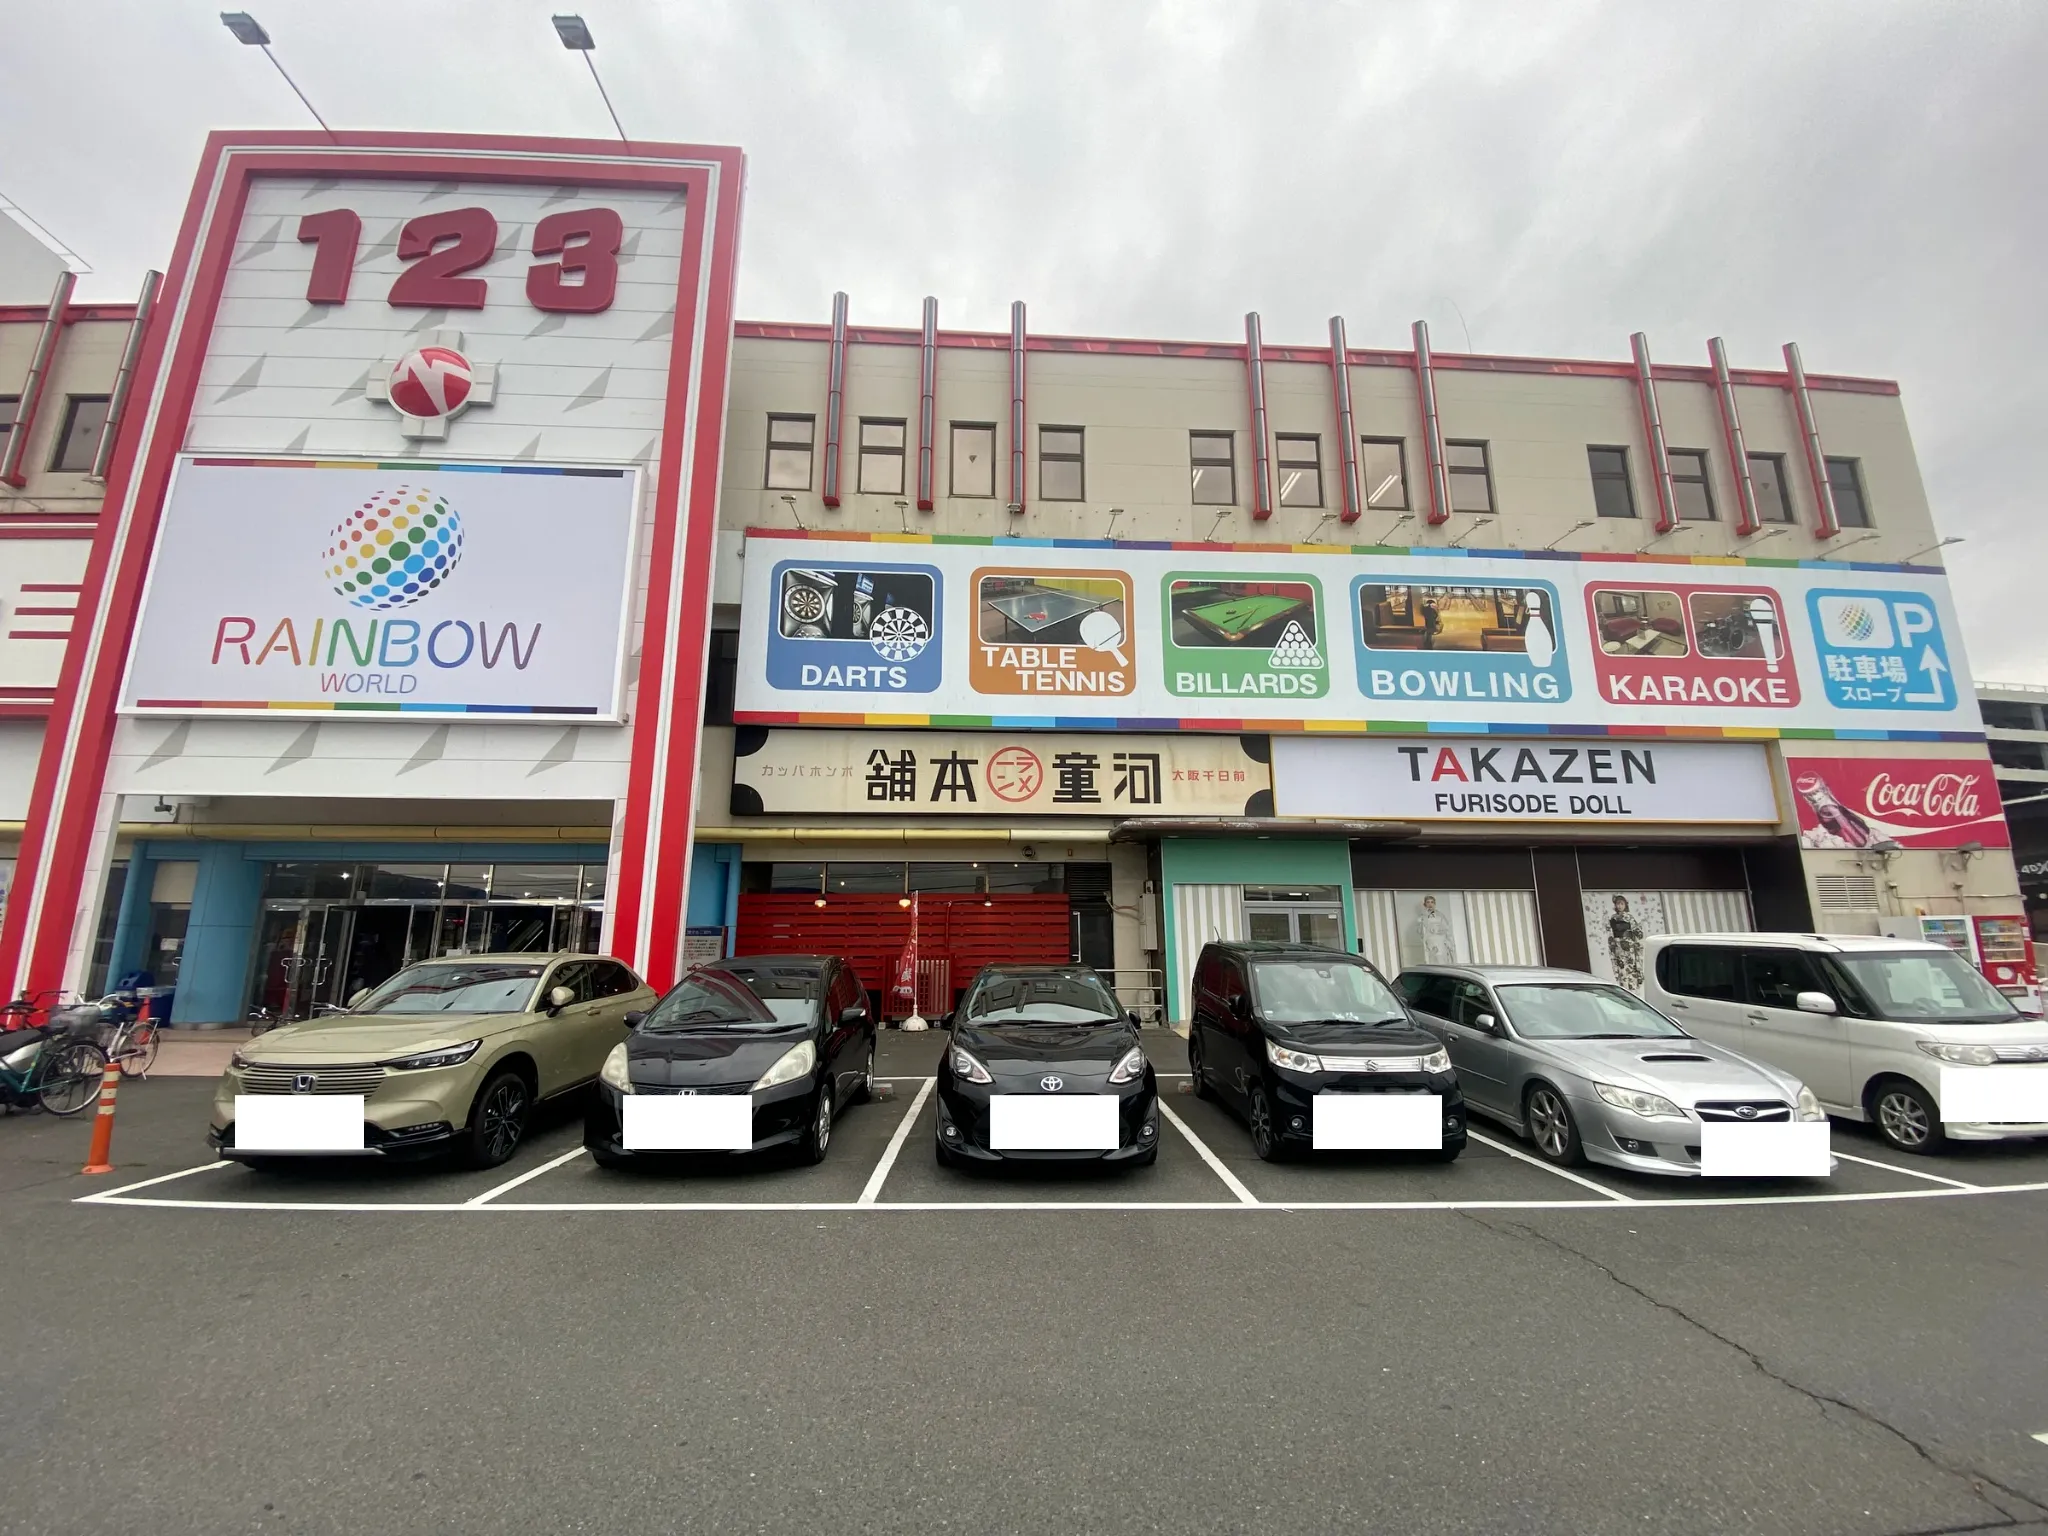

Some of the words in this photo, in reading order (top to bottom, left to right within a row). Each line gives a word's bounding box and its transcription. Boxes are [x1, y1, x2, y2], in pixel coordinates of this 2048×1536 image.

[297, 207, 623, 313] 123
[1893, 602, 1933, 648] P
[211, 616, 542, 670] RAINBOW
[980, 646, 1077, 668] TABLE
[1824, 654, 1908, 684] 駐車場
[320, 673, 417, 693] WORLD
[801, 664, 907, 688] DARTS
[1015, 670, 1126, 692] TENNIS
[1176, 672, 1318, 695] BILLARDS
[1371, 669, 1560, 699] BOWLING
[1609, 674, 1790, 703] KARAOKE
[1840, 686, 1903, 702] スロープ
[1172, 769, 1245, 781] 大阪千日前
[1397, 746, 1656, 784] TAKAZEN
[1434, 793, 1558, 813] FURISODE
[1569, 795, 1632, 814] DOLL
[1863, 772, 1981, 817] Coca-Cola
